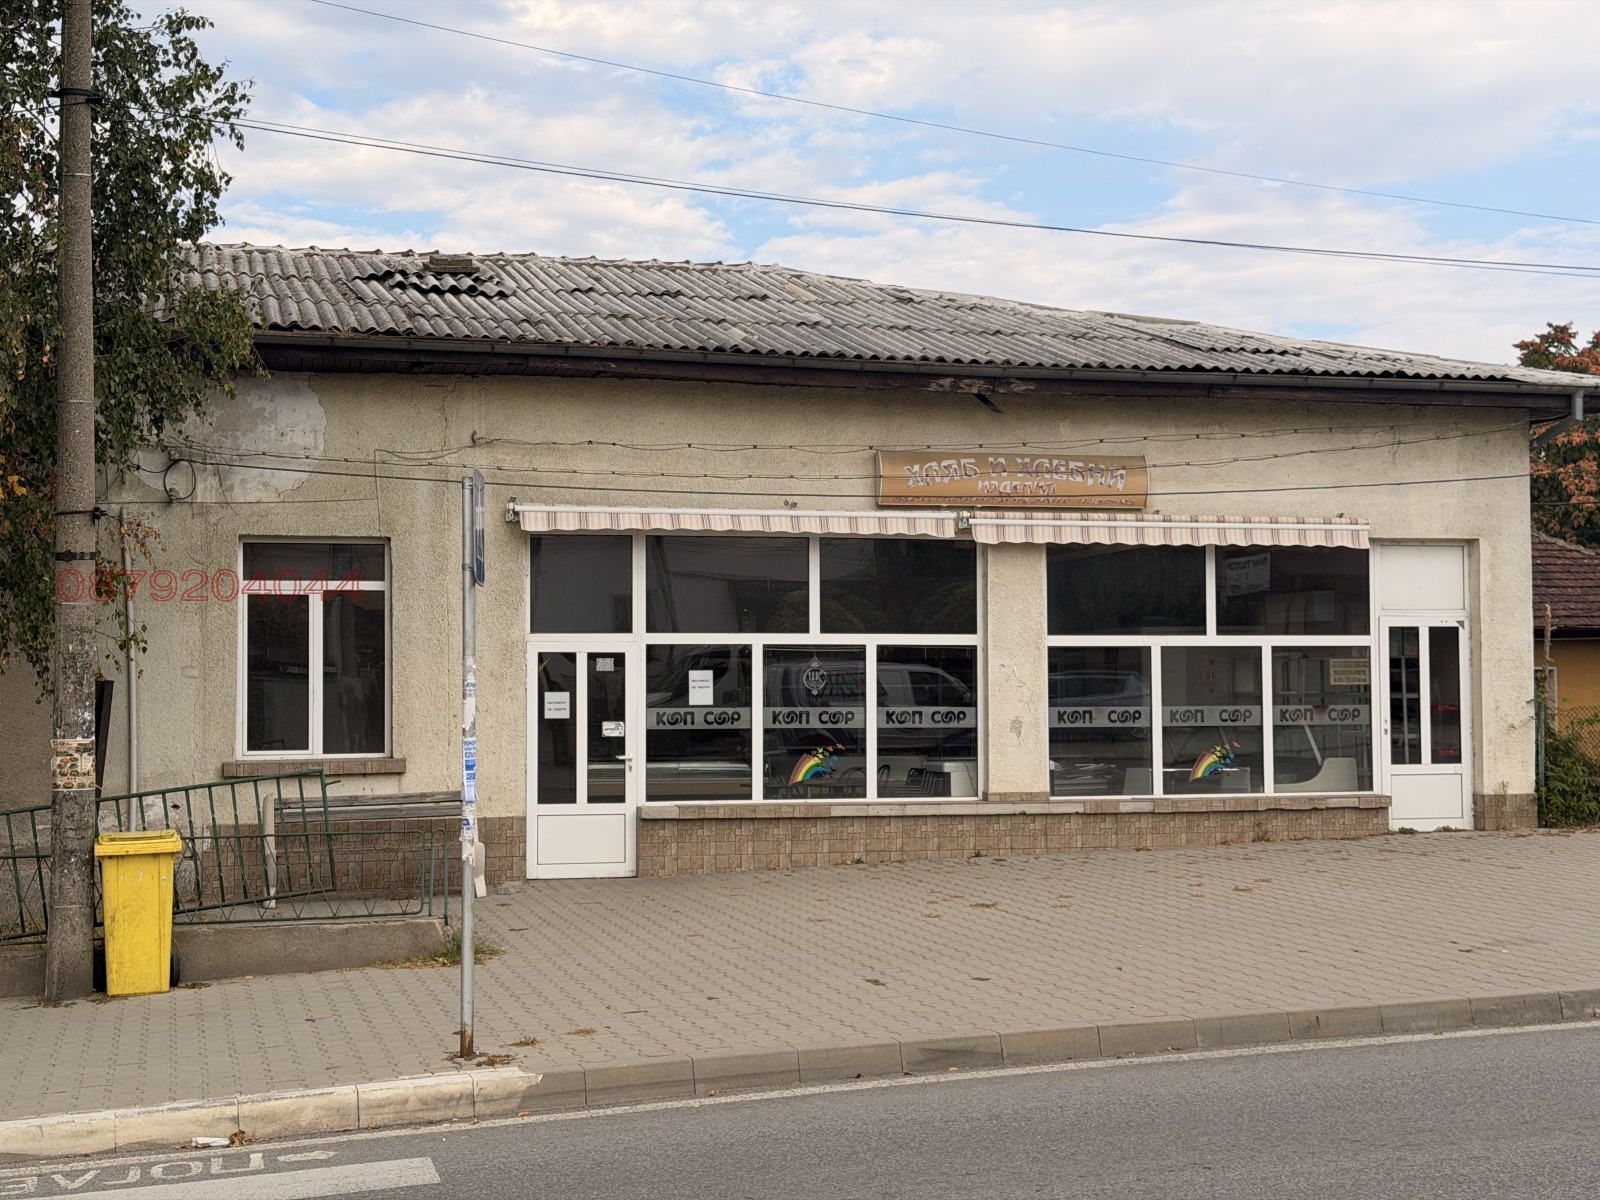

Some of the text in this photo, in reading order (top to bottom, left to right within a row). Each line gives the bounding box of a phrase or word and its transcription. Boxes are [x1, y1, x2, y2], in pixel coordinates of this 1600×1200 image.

[904, 457, 1127, 492] ХЛЯБ И ХЛЕБНИ
